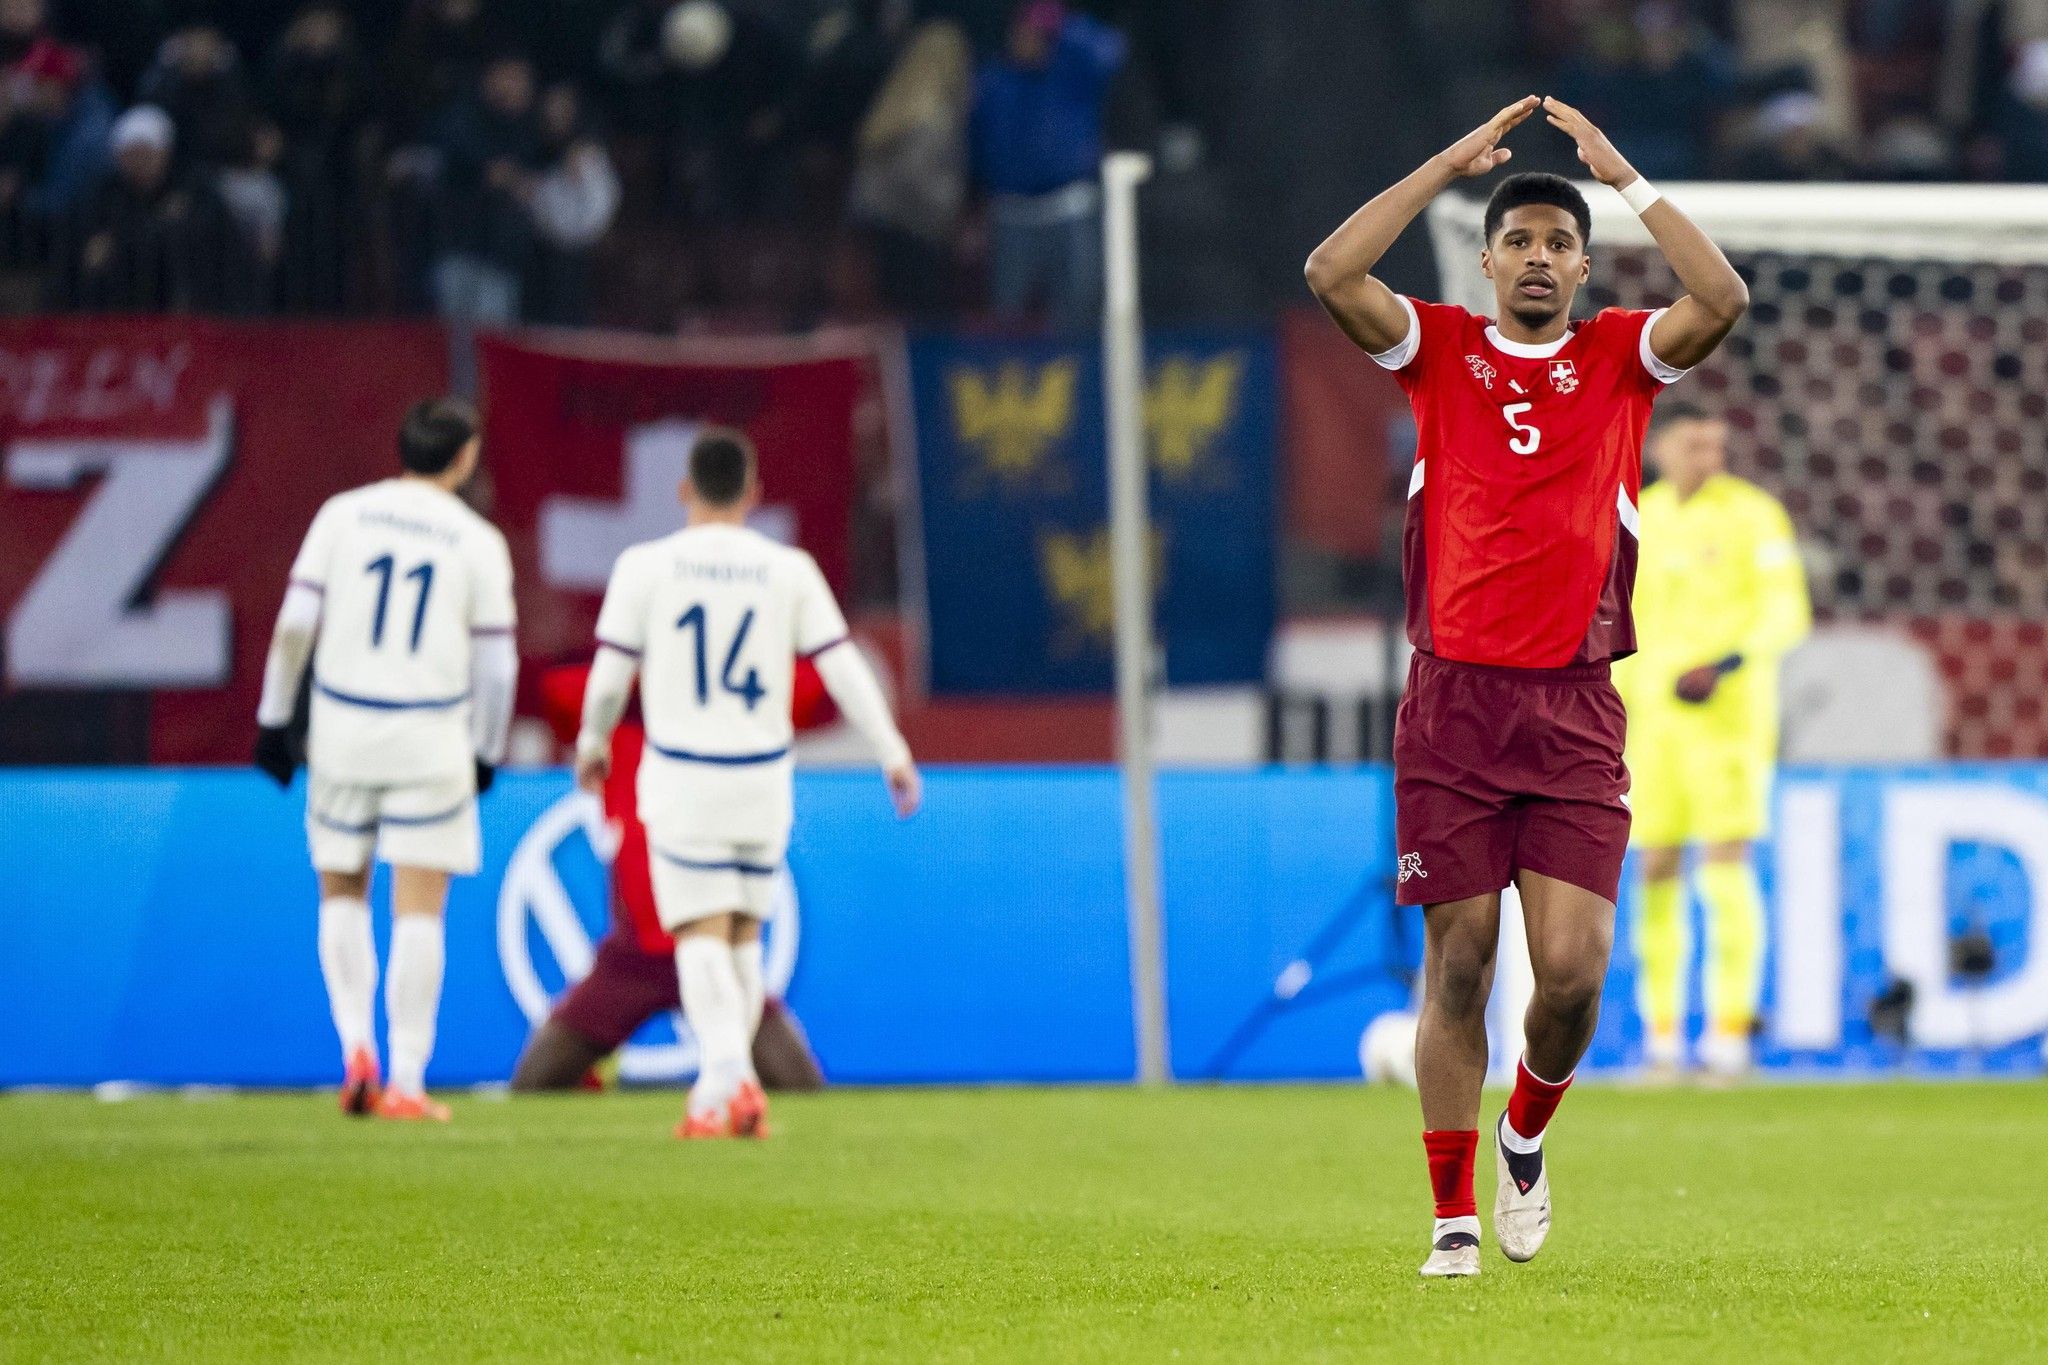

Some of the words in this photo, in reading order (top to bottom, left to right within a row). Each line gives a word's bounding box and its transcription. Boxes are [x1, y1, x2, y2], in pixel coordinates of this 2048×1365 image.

[1503, 402, 1541, 455] 5
[5, 393, 234, 687] Z
[366, 552, 434, 653] 11
[676, 603, 767, 711] 14
